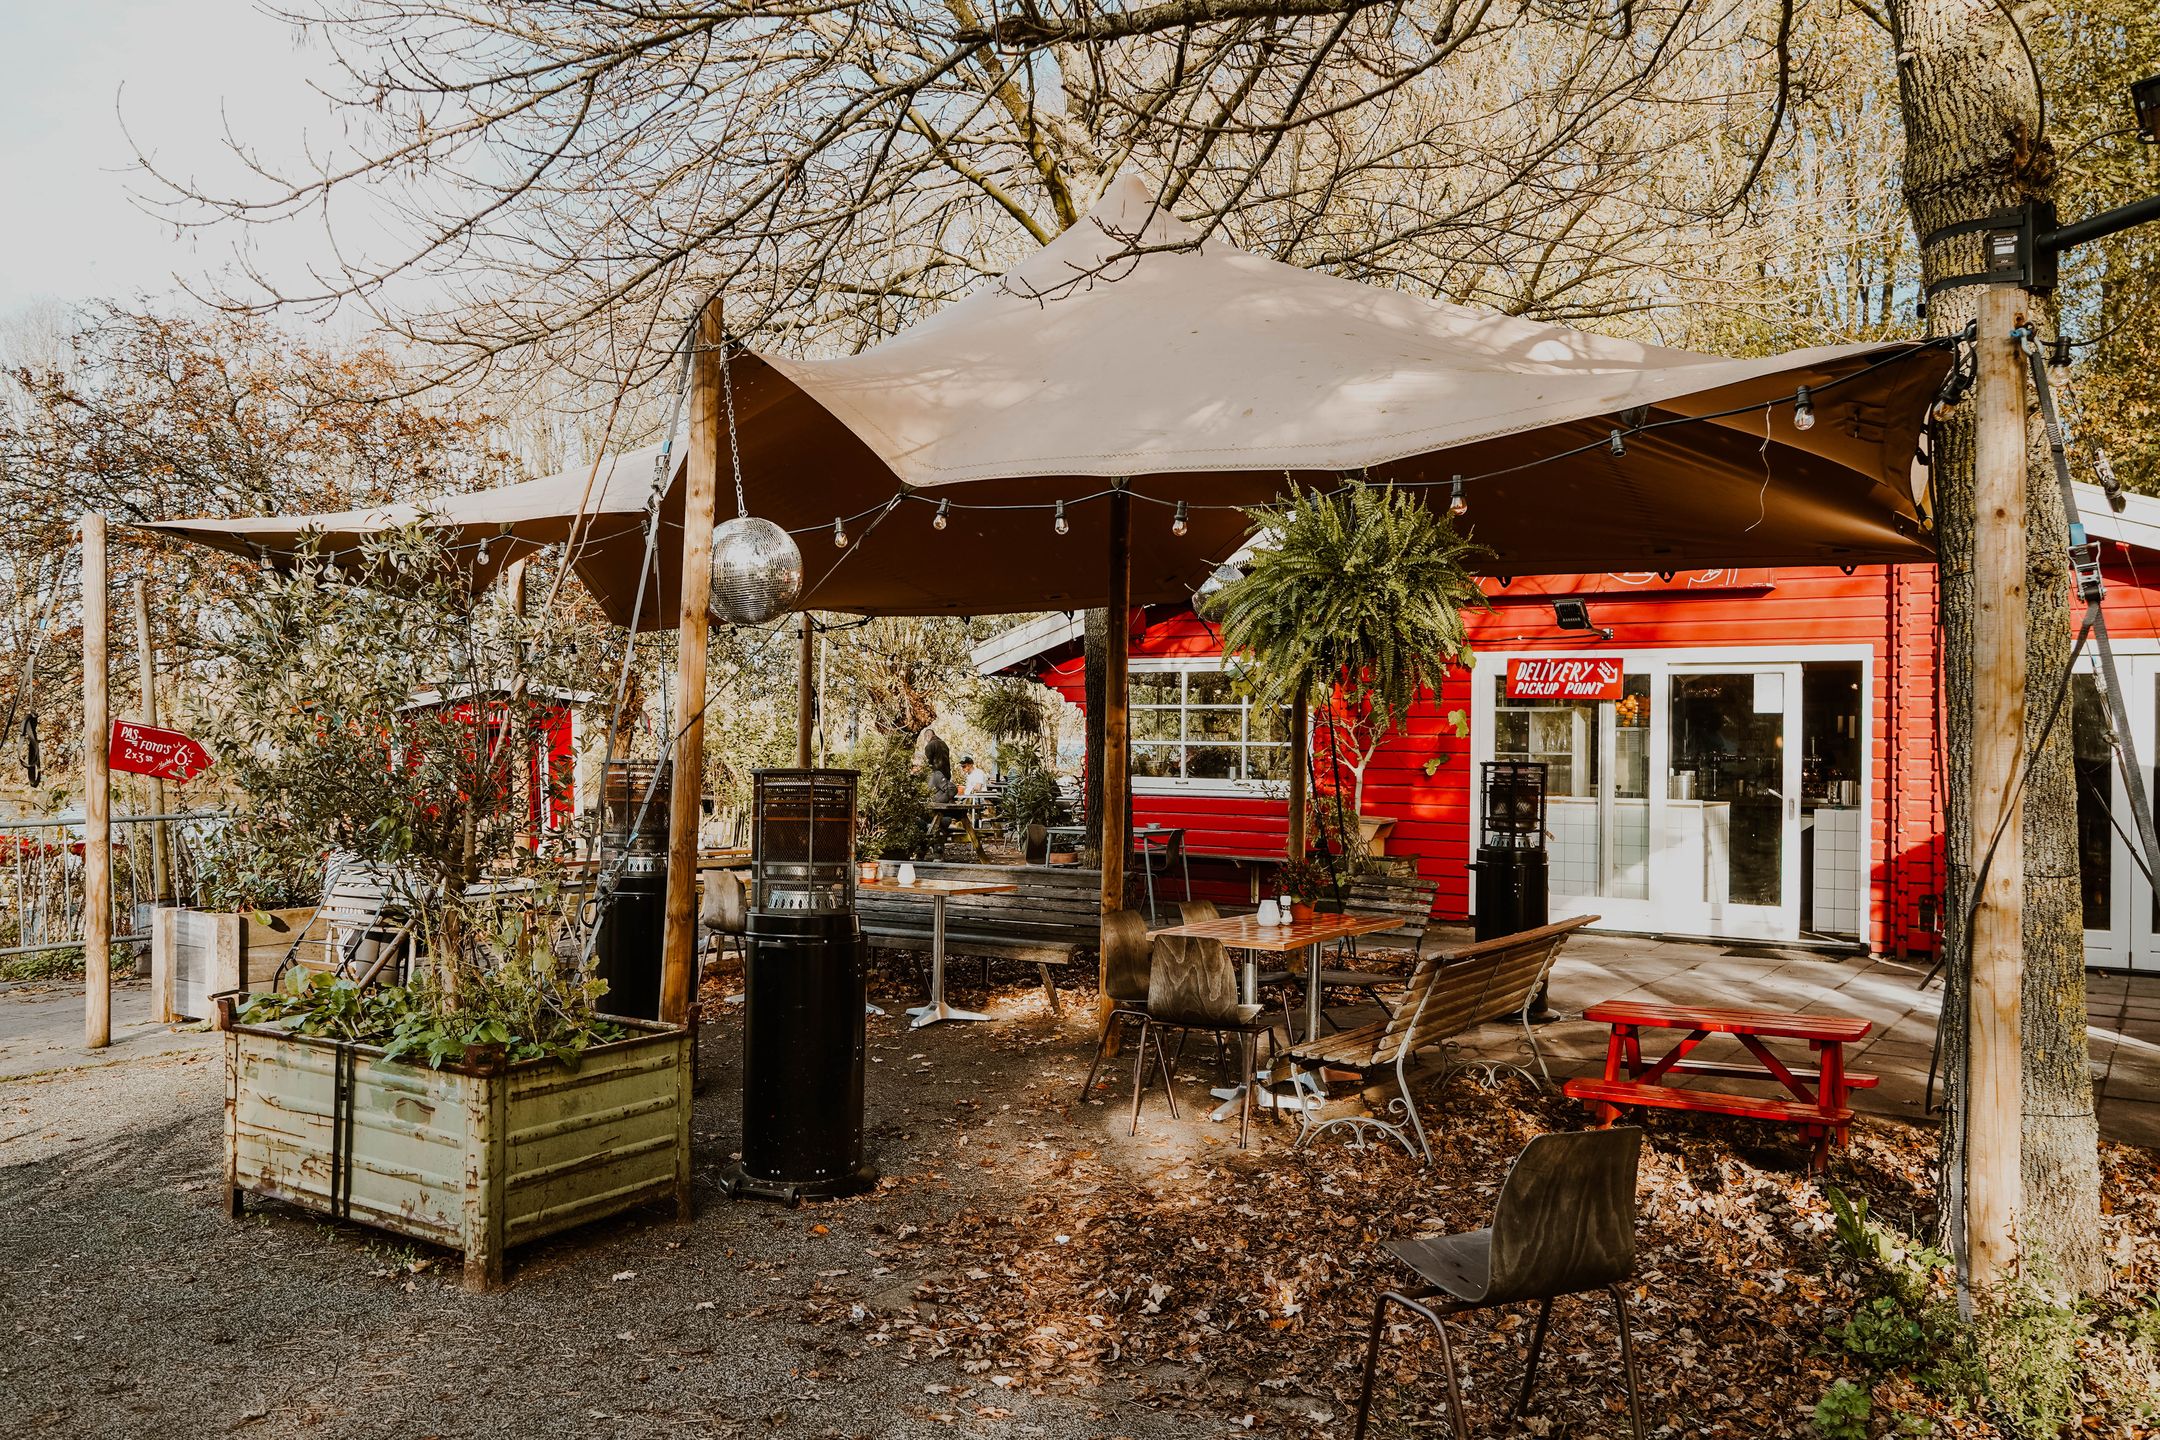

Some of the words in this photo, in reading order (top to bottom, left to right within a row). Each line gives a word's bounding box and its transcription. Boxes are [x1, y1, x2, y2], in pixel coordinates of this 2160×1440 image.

[1515, 681, 1560, 695] PICKUP
[1564, 682, 1605, 695] POINT
[121, 726, 143, 740] PAS-
[139, 741, 172, 754] FOTO'S
